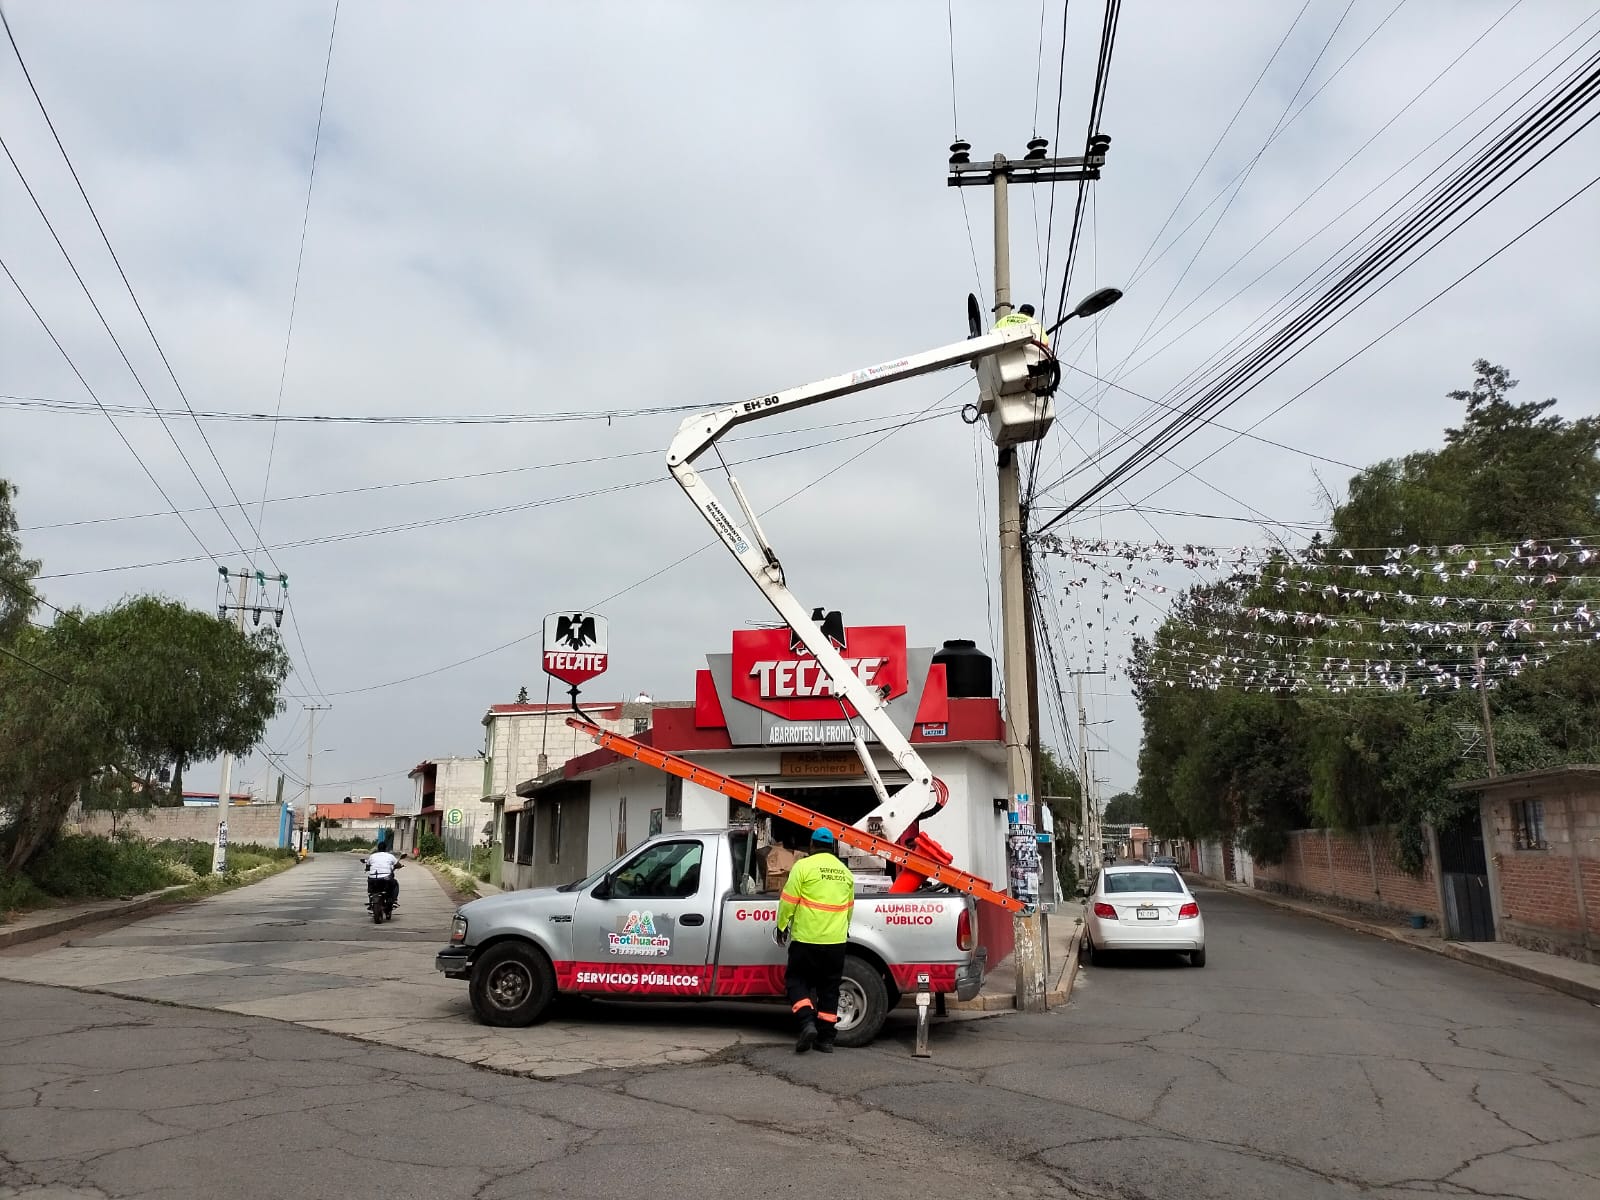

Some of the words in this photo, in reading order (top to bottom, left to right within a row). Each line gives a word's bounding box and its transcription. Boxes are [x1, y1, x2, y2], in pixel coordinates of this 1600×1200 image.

[743, 395, 779, 412] EH-80
[544, 652, 605, 671] TECATE
[769, 726, 813, 743] ABARROTES
[814, 726, 825, 742] LA
[790, 764, 801, 773] La
[804, 763, 847, 773] Frontera
[819, 867, 846, 875] SERVICIOS
[874, 904, 944, 913] ALUMBRADO
[886, 913, 933, 925] PÚBLICO
[609, 935, 669, 947] Teotihuacán
[576, 972, 639, 985] SERVICIOS
[640, 972, 699, 987] PÚBLICOS
